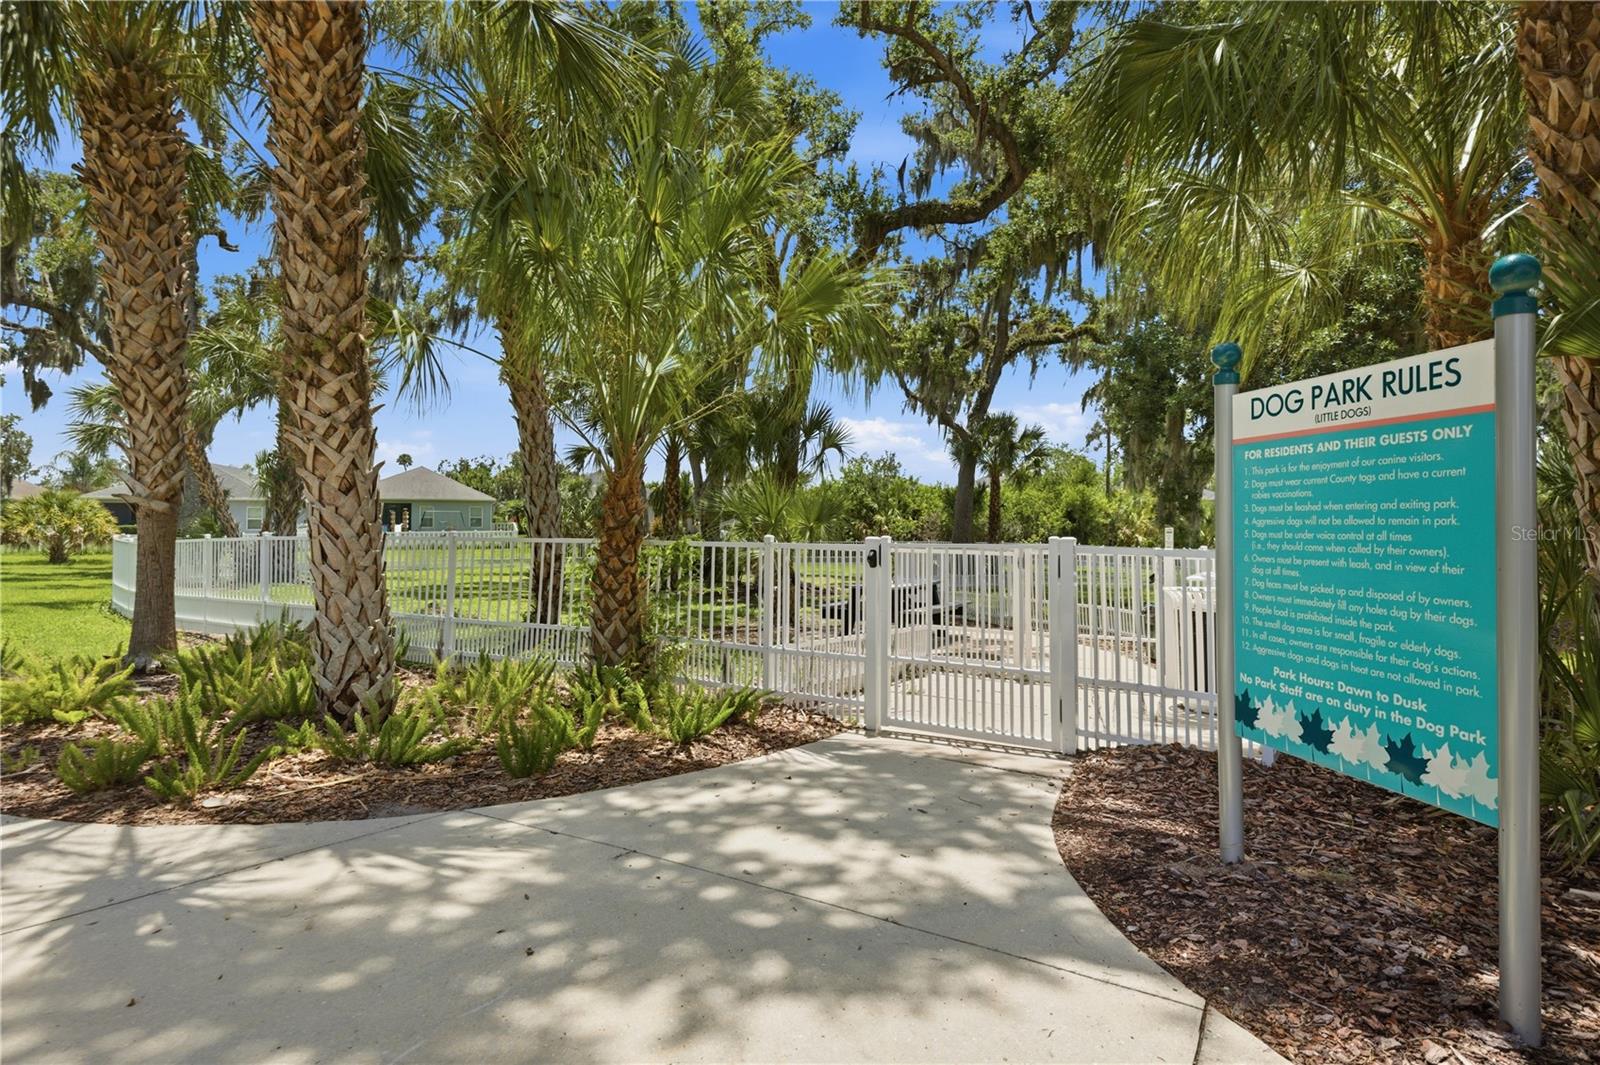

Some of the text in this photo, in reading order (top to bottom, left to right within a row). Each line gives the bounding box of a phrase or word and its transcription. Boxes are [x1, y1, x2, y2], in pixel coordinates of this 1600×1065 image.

[1251, 358, 1462, 420] DOG PARK RULES
[1315, 406, 1371, 424] (LITTLE DOGS)
[1244, 424, 1473, 460] FOR RESIDENTS AND THEIR GUESTS ONLY
[1252, 466, 1263, 475] This
[1265, 464, 1280, 477] park
[1287, 462, 1297, 472] for
[1300, 461, 1310, 472] the
[1311, 460, 1349, 473] enjoyment
[1351, 456, 1360, 467] of
[1378, 454, 1406, 465] canine
[1409, 452, 1444, 463] visitors.
[1251, 480, 1267, 490] Dogs
[1268, 479, 1283, 487] must
[1303, 476, 1328, 485] current
[1330, 474, 1357, 485] County
[1359, 474, 1376, 484] tags
[1378, 470, 1395, 480] and
[1398, 468, 1420, 480] have
[1431, 467, 1466, 478] current
[1251, 504, 1267, 514] Dogs
[1284, 502, 1293, 512] be
[1295, 500, 1321, 512] leashed
[1323, 500, 1343, 510] when
[1345, 501, 1378, 512] entering
[1380, 498, 1397, 509] and
[1399, 499, 1430, 511] exiting
[1433, 496, 1459, 511] park.
[1252, 490, 1270, 499] rabies
[1251, 514, 1460, 528] Aggressive dogs will not be allowed remain in park.
[1251, 530, 1267, 540] Dogs
[1268, 531, 1283, 539] must
[1284, 529, 1293, 539] be
[1295, 529, 1314, 539] under
[1316, 531, 1335, 540] voice
[1337, 530, 1364, 540] control
[1377, 530, 1387, 541] all
[1267, 540, 1450, 559] they should come when called by their owners).
[1251, 554, 1465, 574] Owners must be present with leash, and in view of their
[1251, 565, 1264, 576] dog
[1251, 578, 1264, 589] Dog
[1300, 581, 1309, 591] be
[1310, 584, 1334, 594] picked
[1336, 588, 1346, 598] up
[1348, 587, 1363, 597] and
[1366, 588, 1404, 601] disposed
[1406, 591, 1416, 602] of
[1419, 592, 1430, 606] by
[1433, 597, 1472, 608] owners.
[1251, 591, 1275, 602] Owners
[1293, 596, 1335, 611] immediately
[1337, 599, 1346, 610] fill
[1348, 604, 1364, 615] any
[1366, 602, 1387, 615] holes
[1390, 605, 1407, 620] dug
[1410, 608, 1421, 622] by
[1424, 609, 1446, 622] their
[1449, 613, 1478, 628] dogs.
[1252, 604, 1397, 632] People food prohibited inside the park.
[1252, 617, 1461, 660] The small dog area for small, fragile elderly dogs.
[1259, 631, 1268, 640] all
[1289, 639, 1313, 649] owners
[1315, 643, 1328, 652] are
[1329, 646, 1374, 660] responsible
[1375, 650, 1387, 662] for
[1390, 653, 1409, 666] their
[1412, 658, 1439, 674] dog's
[1442, 666, 1480, 680] actions.
[1253, 644, 1483, 697] Aggressive dogs and dogs heat are not allowed in park.
[1273, 666, 1427, 712] Park Hours: Dawn to Dusk
[1240, 672, 1487, 746] No Park Staff are on duty in the Dog Park
